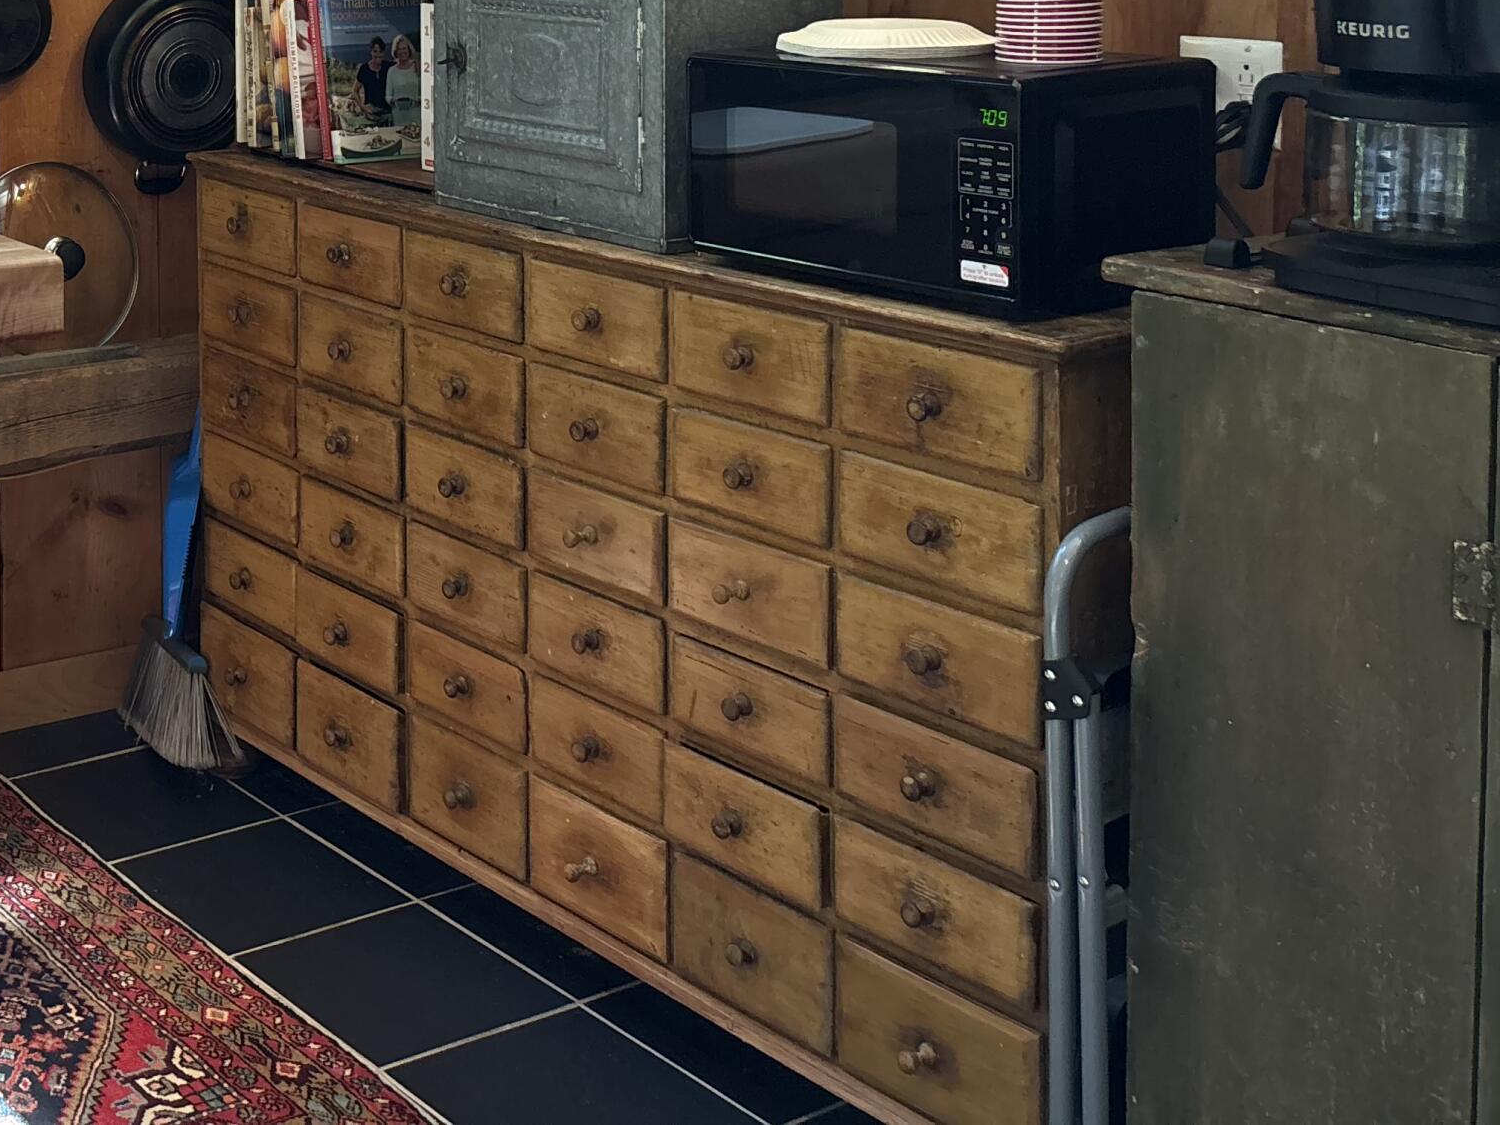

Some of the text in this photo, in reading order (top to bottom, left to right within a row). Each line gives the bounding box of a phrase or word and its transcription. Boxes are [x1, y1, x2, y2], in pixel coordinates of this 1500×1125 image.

[424, 26, 429, 36] 1
[1336, 20, 1411, 39] KEURIG
[423, 63, 430, 73] 2
[424, 99, 430, 110] 3
[980, 108, 1008, 127] 7:09
[423, 136, 430, 147] 4
